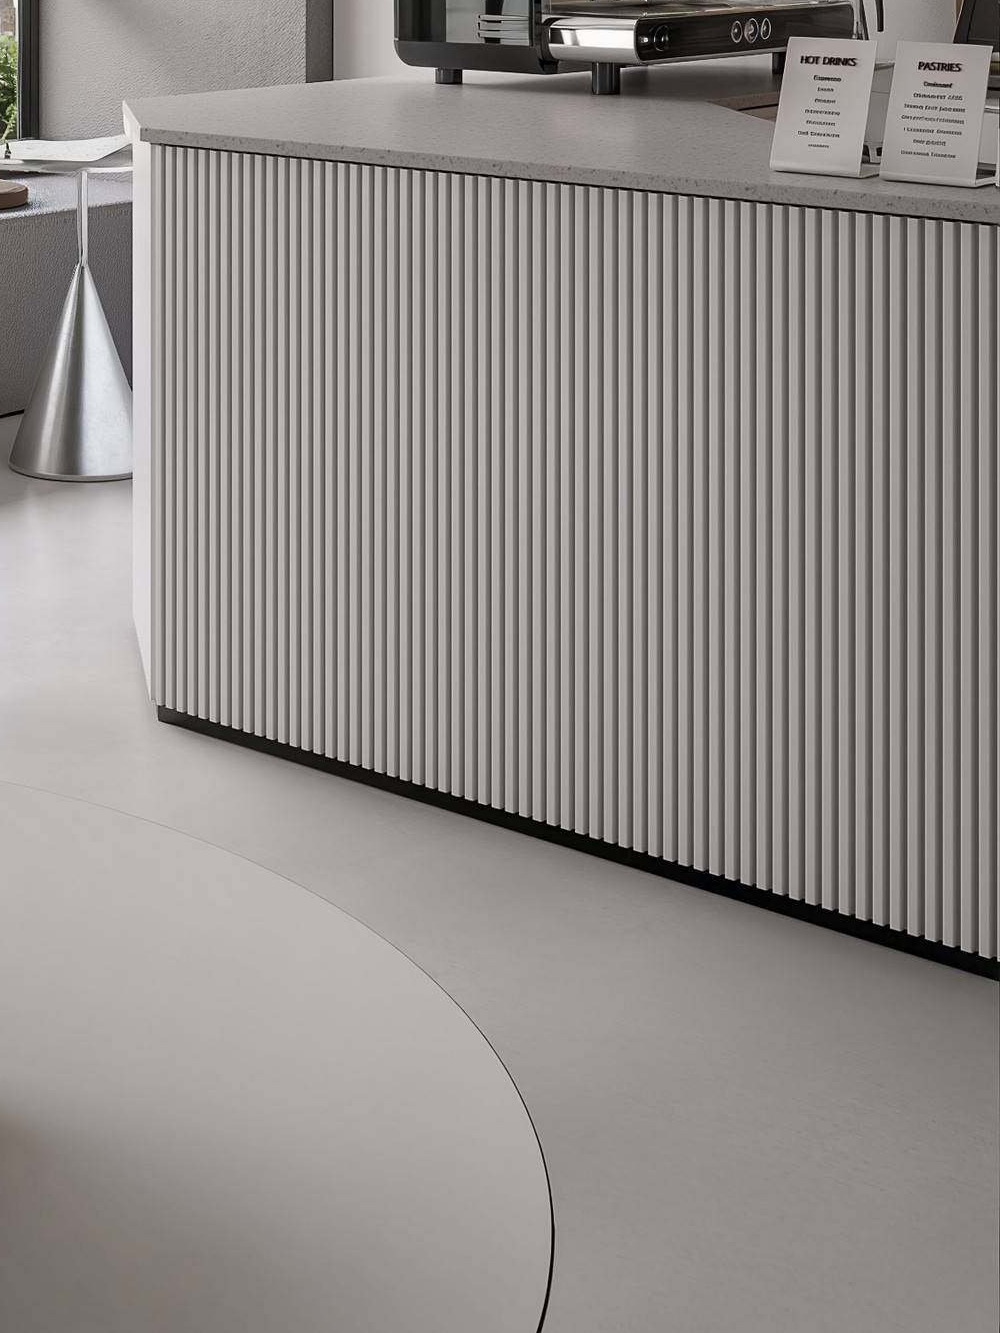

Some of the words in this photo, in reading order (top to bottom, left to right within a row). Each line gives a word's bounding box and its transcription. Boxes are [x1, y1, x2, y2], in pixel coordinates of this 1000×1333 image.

[800, 56, 820, 64] HOT
[823, 57, 856, 66] DRINKS
[918, 62, 962, 72] PASTRIES
